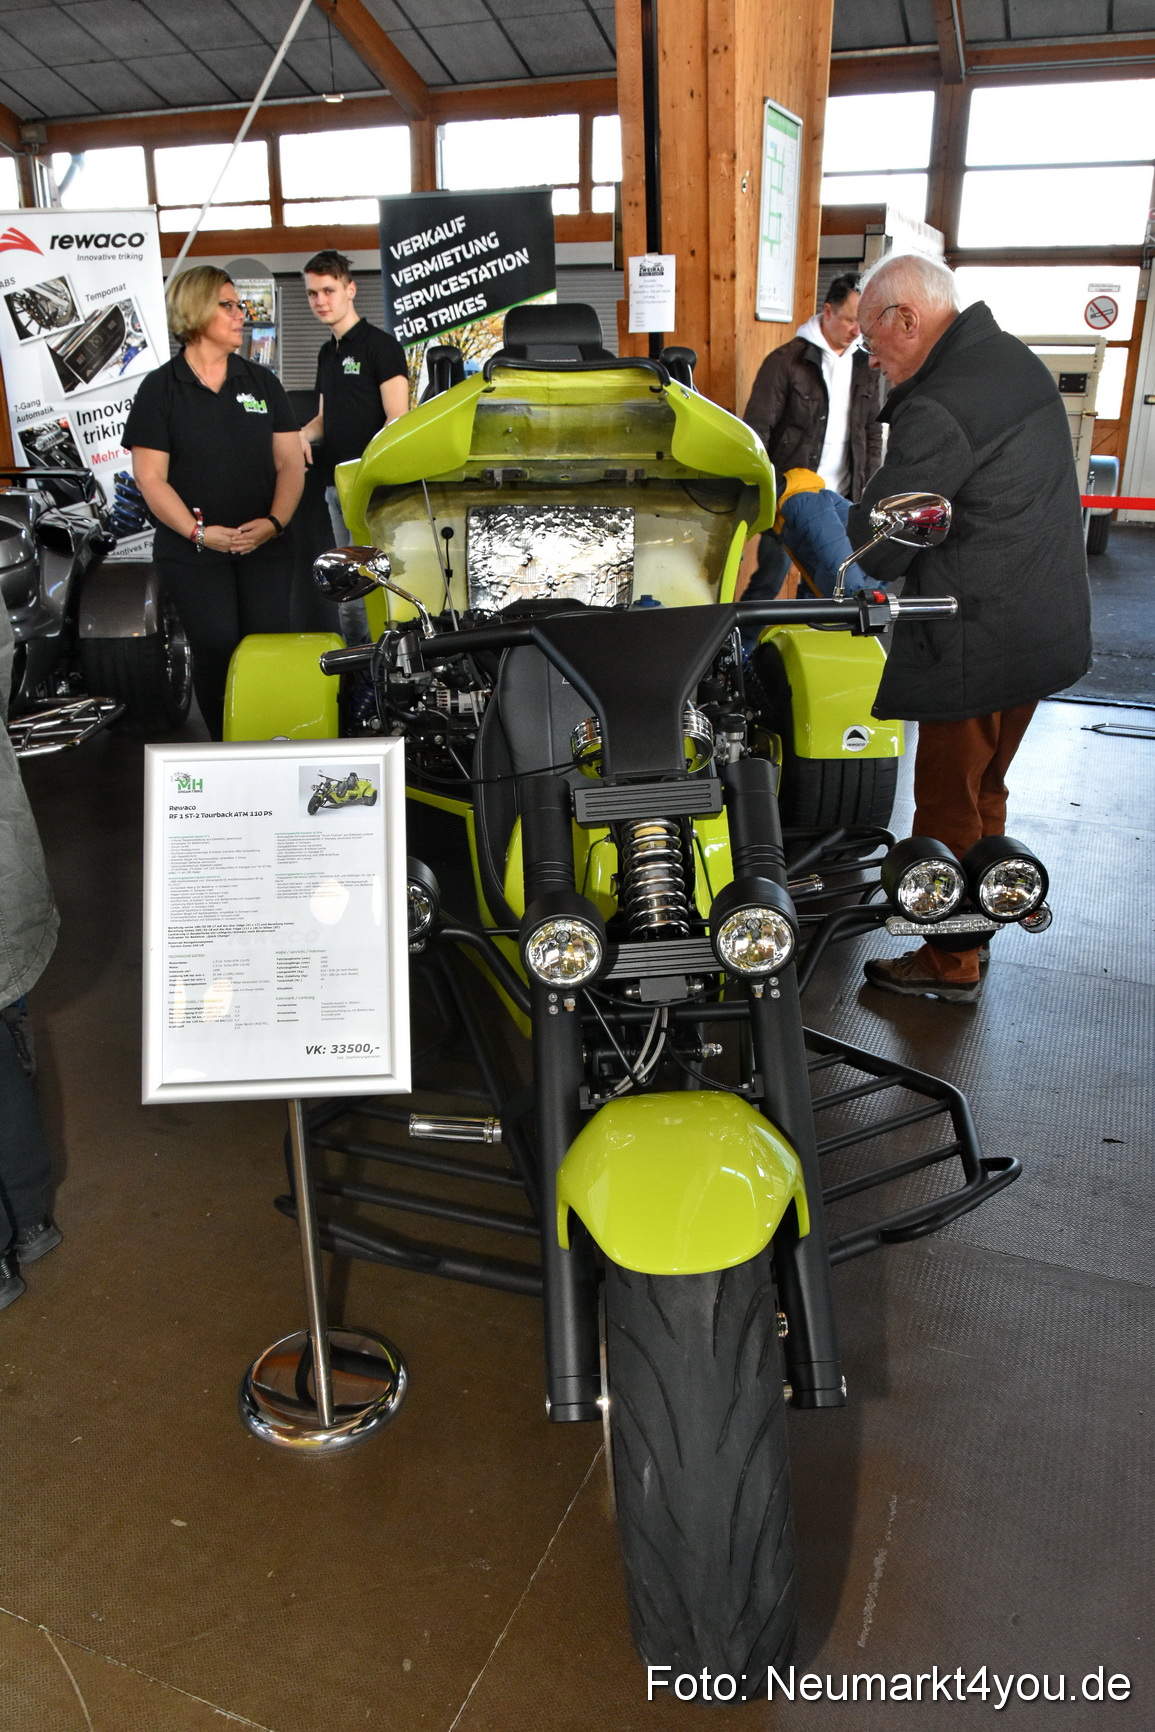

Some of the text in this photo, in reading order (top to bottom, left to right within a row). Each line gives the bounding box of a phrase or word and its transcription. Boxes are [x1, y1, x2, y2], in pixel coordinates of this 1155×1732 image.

[50, 232, 145, 250] rewaco
[390, 215, 466, 260] VERKAUF
[77, 253, 144, 262] Innovative triking
[391, 231, 500, 287] VERMIETUNG
[393, 247, 530, 315] SERVICESTATION
[85, 283, 127, 302] Tempomat
[394, 293, 487, 342] FÜR TRIKES
[16, 406, 55, 424] Automatik
[76, 397, 134, 427] Innova
[83, 421, 126, 445] trikin
[91, 449, 120, 465] Mehr
[305, 1043, 380, 1055] VK: 33500,-
